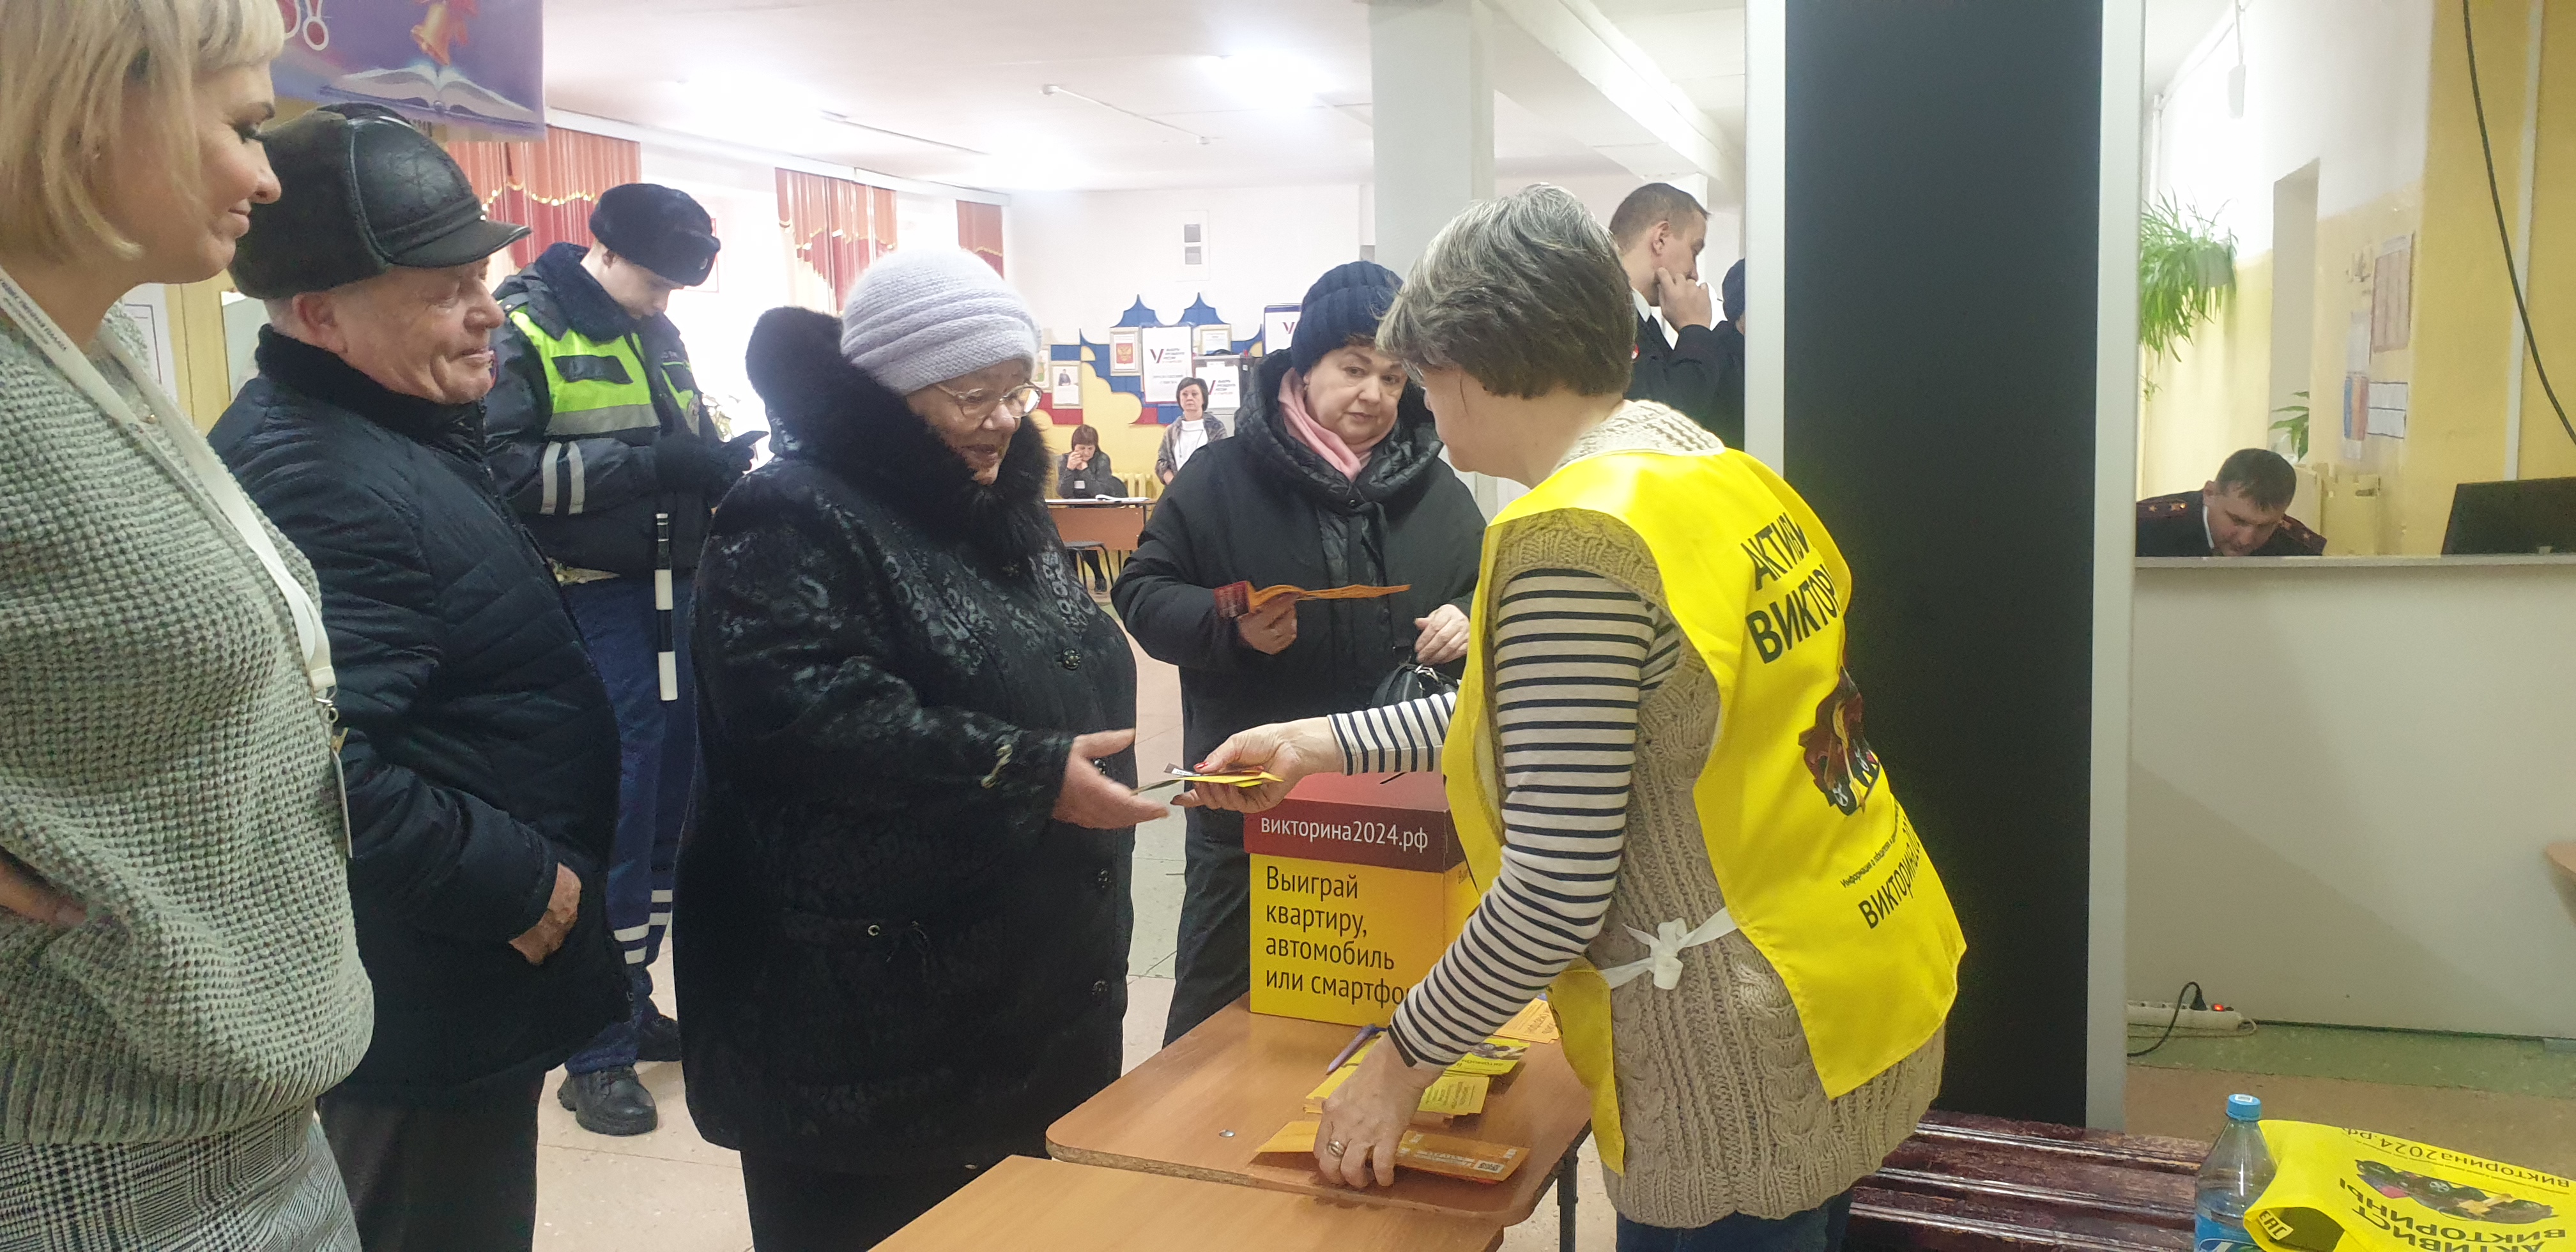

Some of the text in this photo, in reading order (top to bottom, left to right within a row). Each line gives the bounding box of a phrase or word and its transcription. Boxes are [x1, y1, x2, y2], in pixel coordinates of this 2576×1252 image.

[1745, 563, 1841, 664] ВИКТОР
[1261, 818, 1429, 853] викторина2024.рф
[1266, 866, 1358, 902] Выиграй
[1266, 905, 1367, 939] квартиру,
[1266, 937, 1395, 970] автомобиль
[1266, 970, 1409, 1009] или смартфо
[2339, 1177, 2566, 1244] ВИКТОРИНЫ
